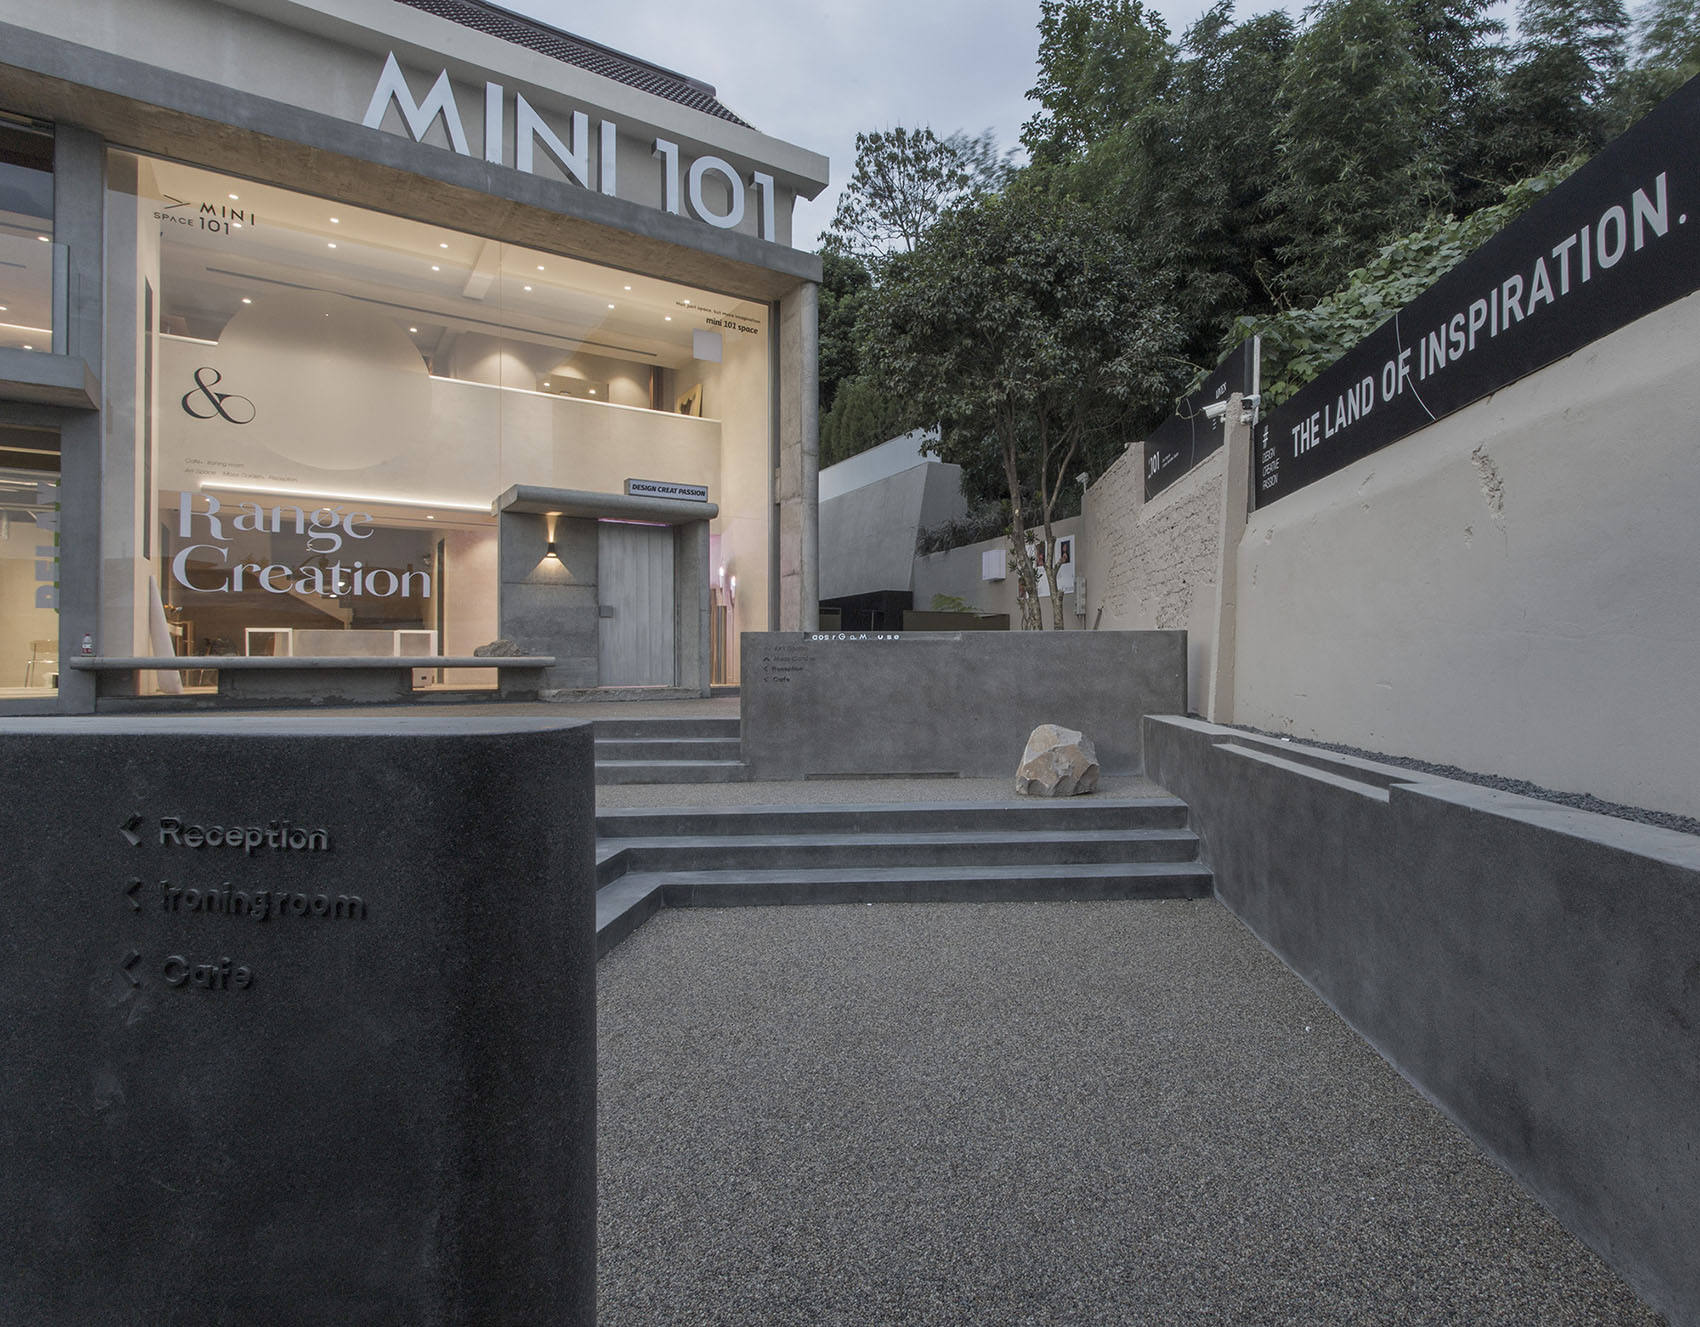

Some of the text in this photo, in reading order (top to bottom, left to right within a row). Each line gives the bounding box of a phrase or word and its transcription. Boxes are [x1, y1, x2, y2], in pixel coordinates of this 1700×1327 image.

[362, 50, 775, 243] MINI 101
[153, 211, 194, 227] SPACE
[200, 202, 255, 226] MINI
[200, 217, 229, 235] 101
[705, 317, 759, 335] mini 101 space
[181, 366, 256, 425] &
[1292, 411, 1320, 458] THE
[1324, 375, 1374, 440] LAND
[1382, 347, 1412, 402] OF
[631, 484, 706, 497] DESIGN CREAT PASSION
[179, 491, 374, 555] Range
[172, 544, 431, 599] Creation
[159, 816, 329, 854] Reception
[161, 954, 253, 990] Cafe
